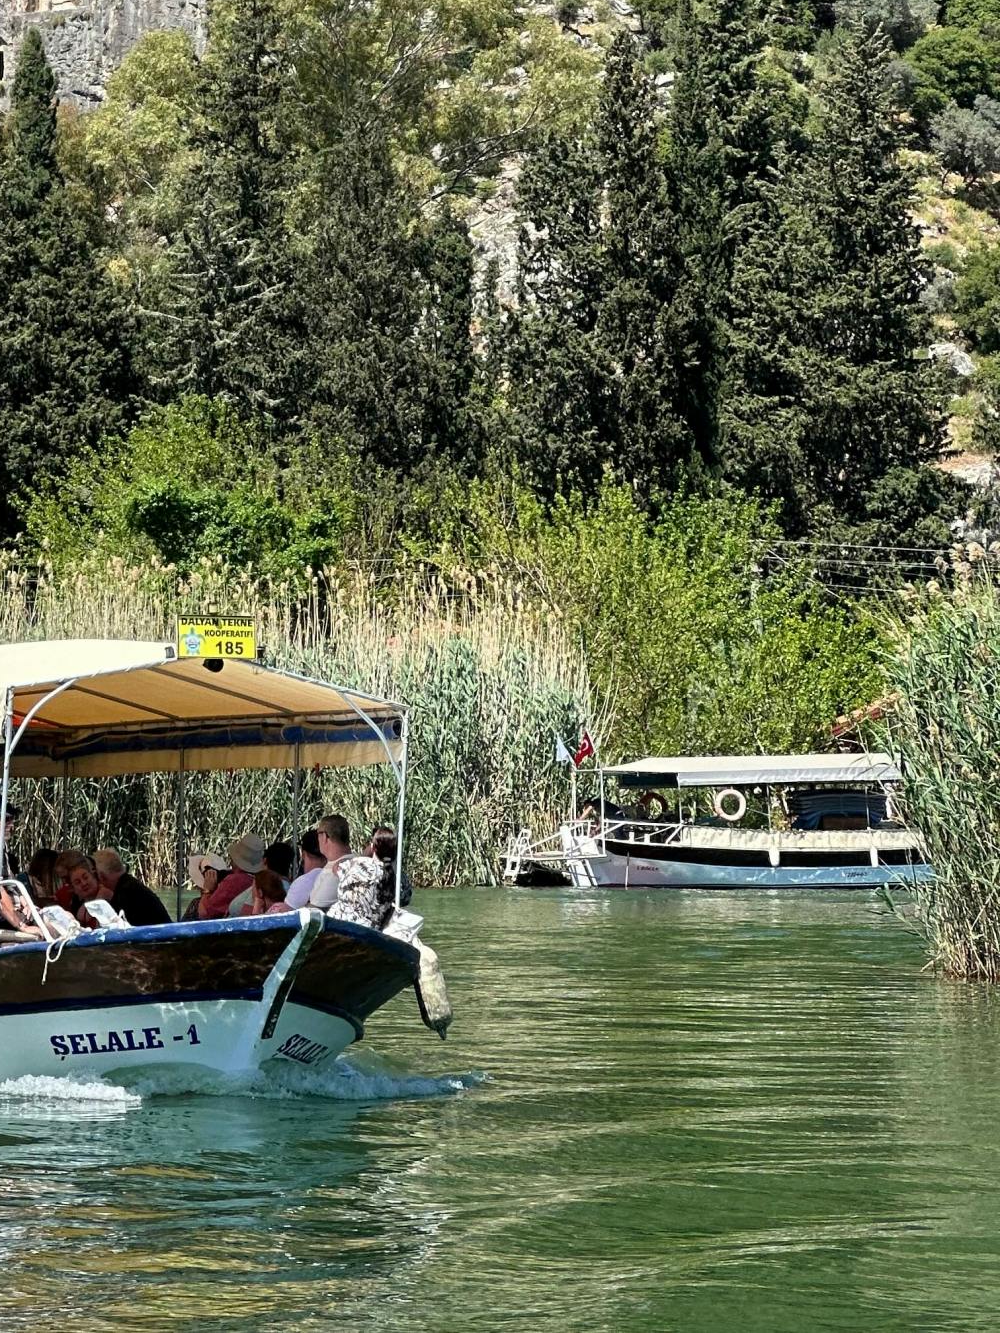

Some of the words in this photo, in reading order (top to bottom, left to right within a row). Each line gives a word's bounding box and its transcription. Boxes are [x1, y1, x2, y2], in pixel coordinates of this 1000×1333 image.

[181, 618, 219, 627] DALYAN
[221, 619, 253, 627] TEKNE
[215, 641, 244, 655] 185
[50, 1027, 164, 1061] ŞELALE
